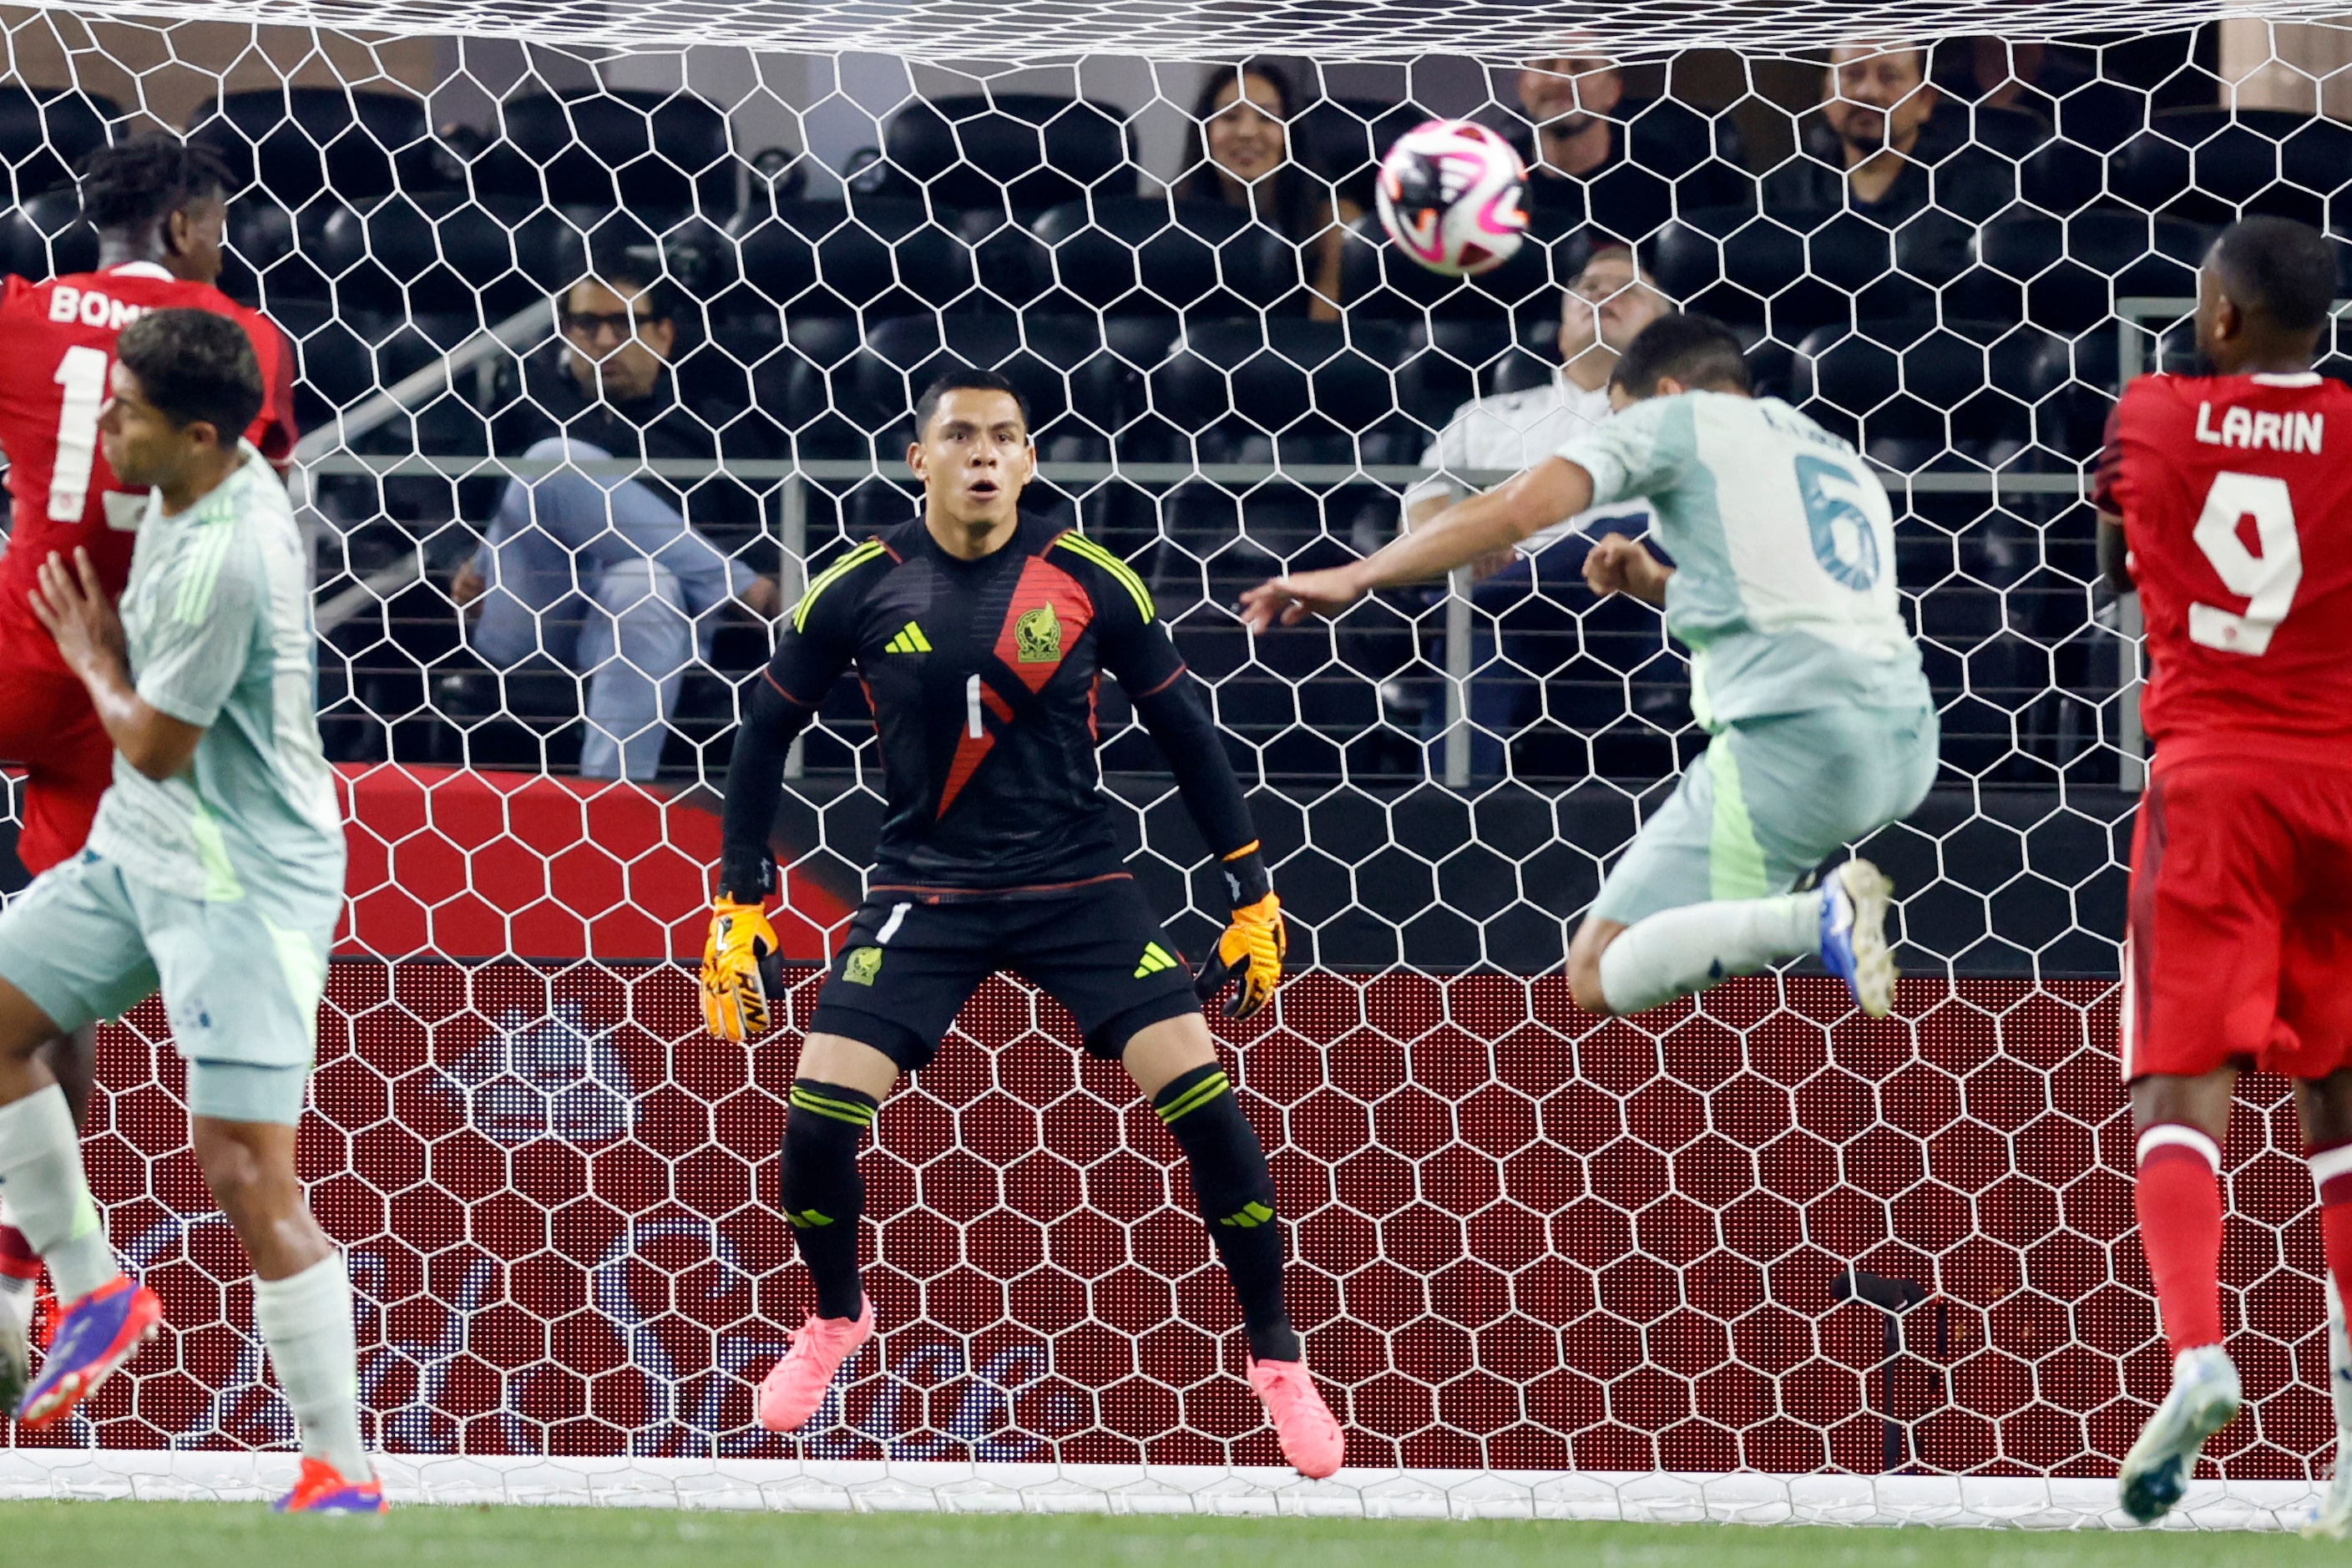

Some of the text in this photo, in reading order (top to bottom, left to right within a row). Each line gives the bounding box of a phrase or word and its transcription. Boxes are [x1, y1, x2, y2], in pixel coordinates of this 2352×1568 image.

[48, 286, 154, 330] BOM
[2194, 399, 2325, 455] LARIN
[1793, 453, 1882, 592] 6
[2188, 471, 2303, 657] 9
[966, 673, 984, 740] 1
[874, 901, 913, 945] 1
